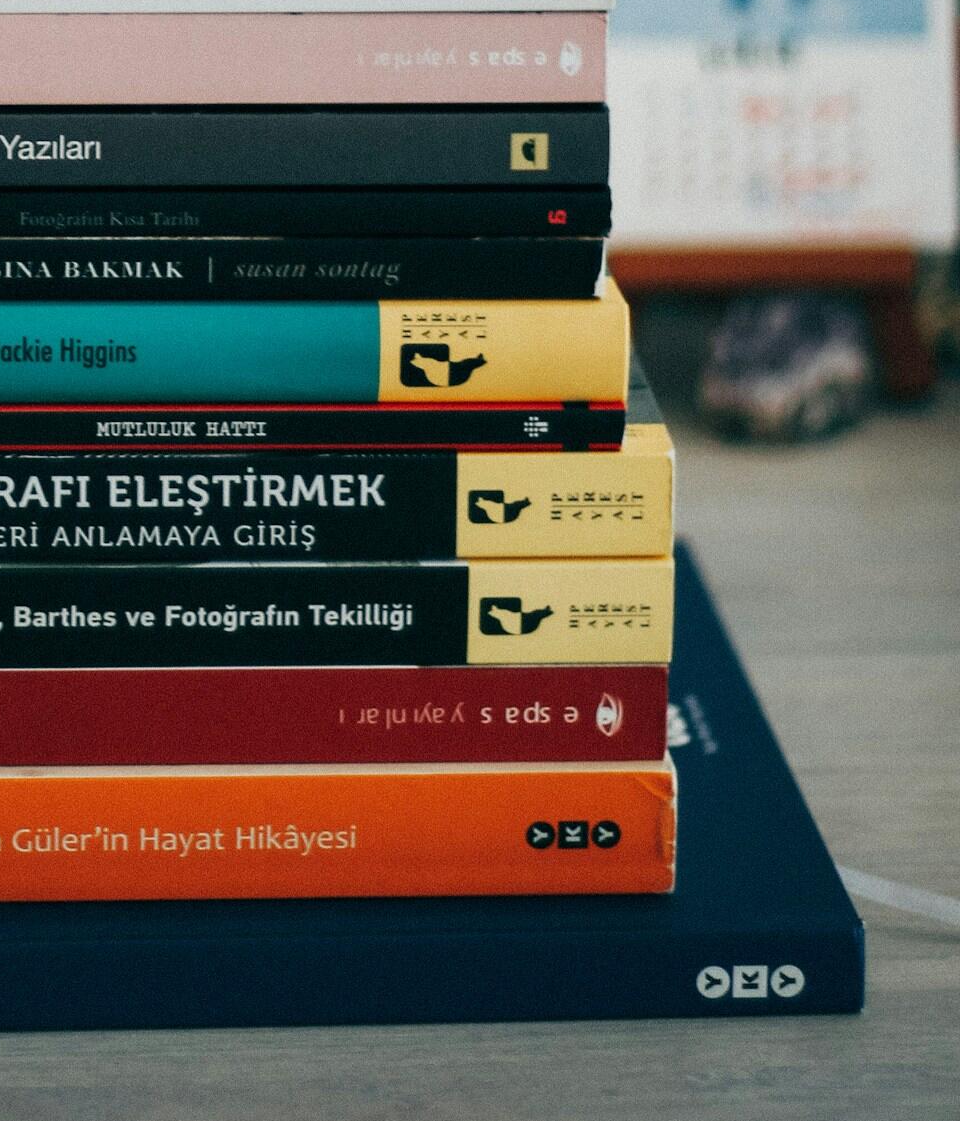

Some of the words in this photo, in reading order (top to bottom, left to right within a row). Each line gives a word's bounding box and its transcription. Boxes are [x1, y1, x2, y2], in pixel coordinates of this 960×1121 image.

[64, 261, 183, 279] BAKMAK
[233, 263, 307, 278] susan
[314, 261, 401, 287] sontag
[59, 337, 138, 369] Higgins
[96, 421, 197, 438] MUTLULUK
[205, 420, 267, 438] HATTI
[106, 466, 386, 517] ELEŞTİRMEK
[51, 525, 221, 548] ANLAMAYA
[233, 519, 316, 552] GİRİŞ
[13, 604, 117, 628] Barthes
[124, 610, 156, 628] ve
[165, 603, 300, 633] Fotoğrafın
[307, 603, 413, 632] Tekilliği
[139, 827, 225, 858] Hayat
[235, 823, 357, 856] Hikâyesi
